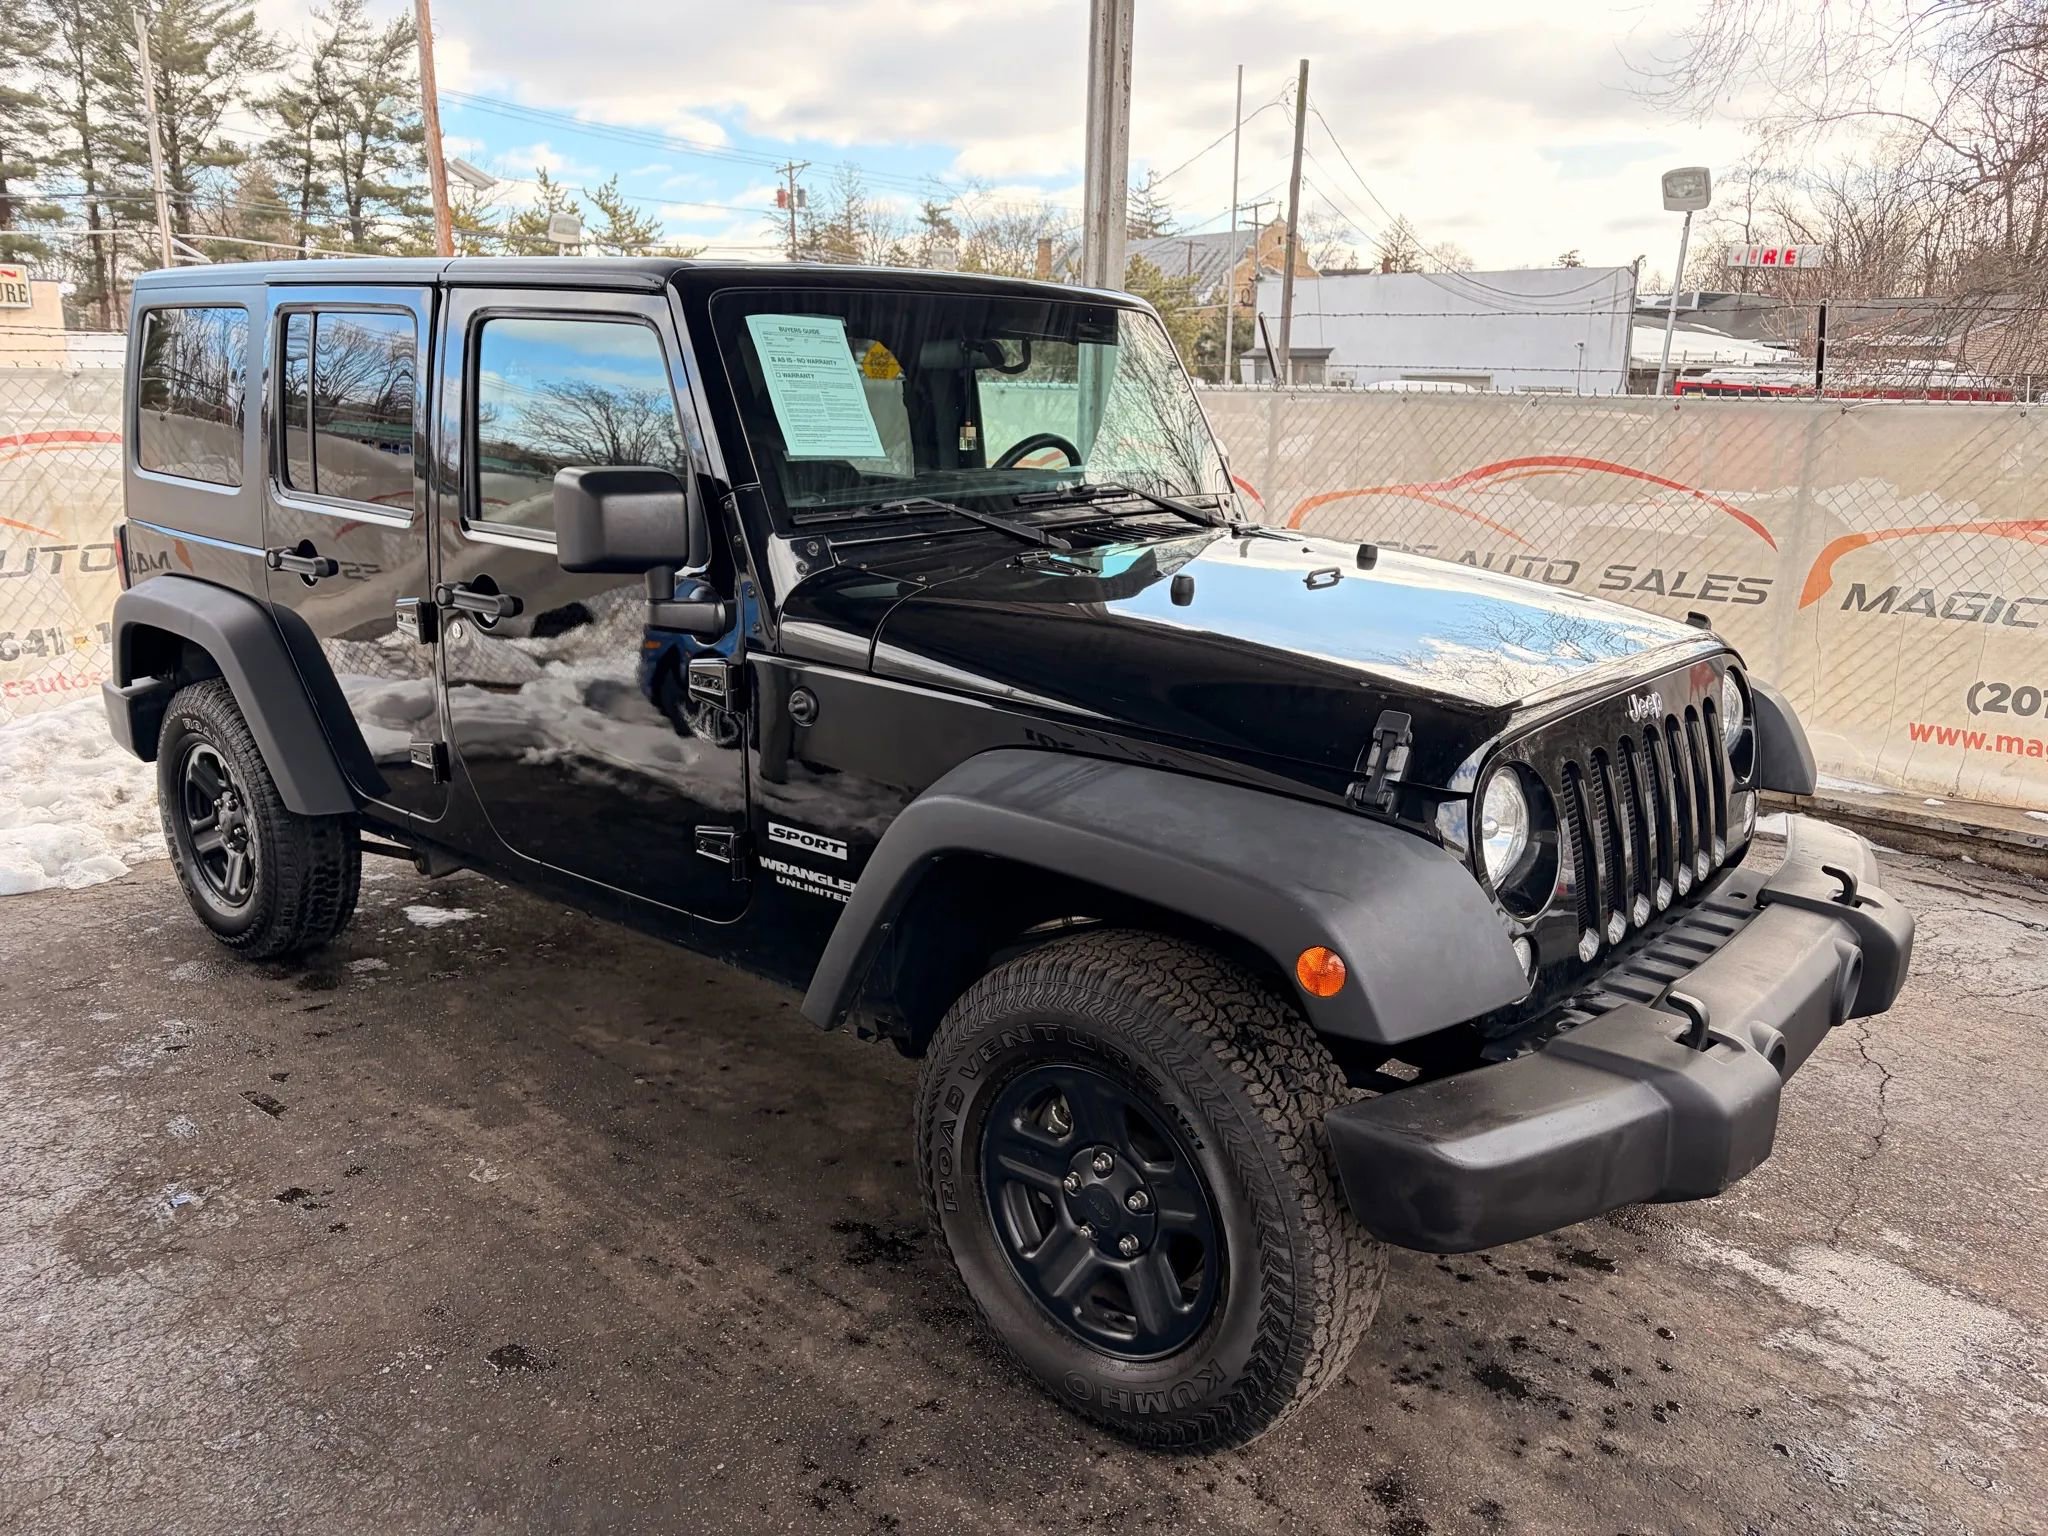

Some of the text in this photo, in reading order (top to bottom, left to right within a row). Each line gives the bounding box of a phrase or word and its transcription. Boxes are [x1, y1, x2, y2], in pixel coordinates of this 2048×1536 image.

[778, 326, 802, 334] BUYERS
[806, 358, 837, 366] WARRANTY
[1599, 564, 1774, 606] SALES
[1840, 583, 2048, 629] MAGIC
[1628, 691, 1662, 722] Jeep
[1909, 722, 2048, 762] www.ma
[772, 827, 841, 854] SPORT
[937, 1022, 1164, 1213] ROAD VENTURE
[1064, 1358, 1227, 1415] KUMHO
